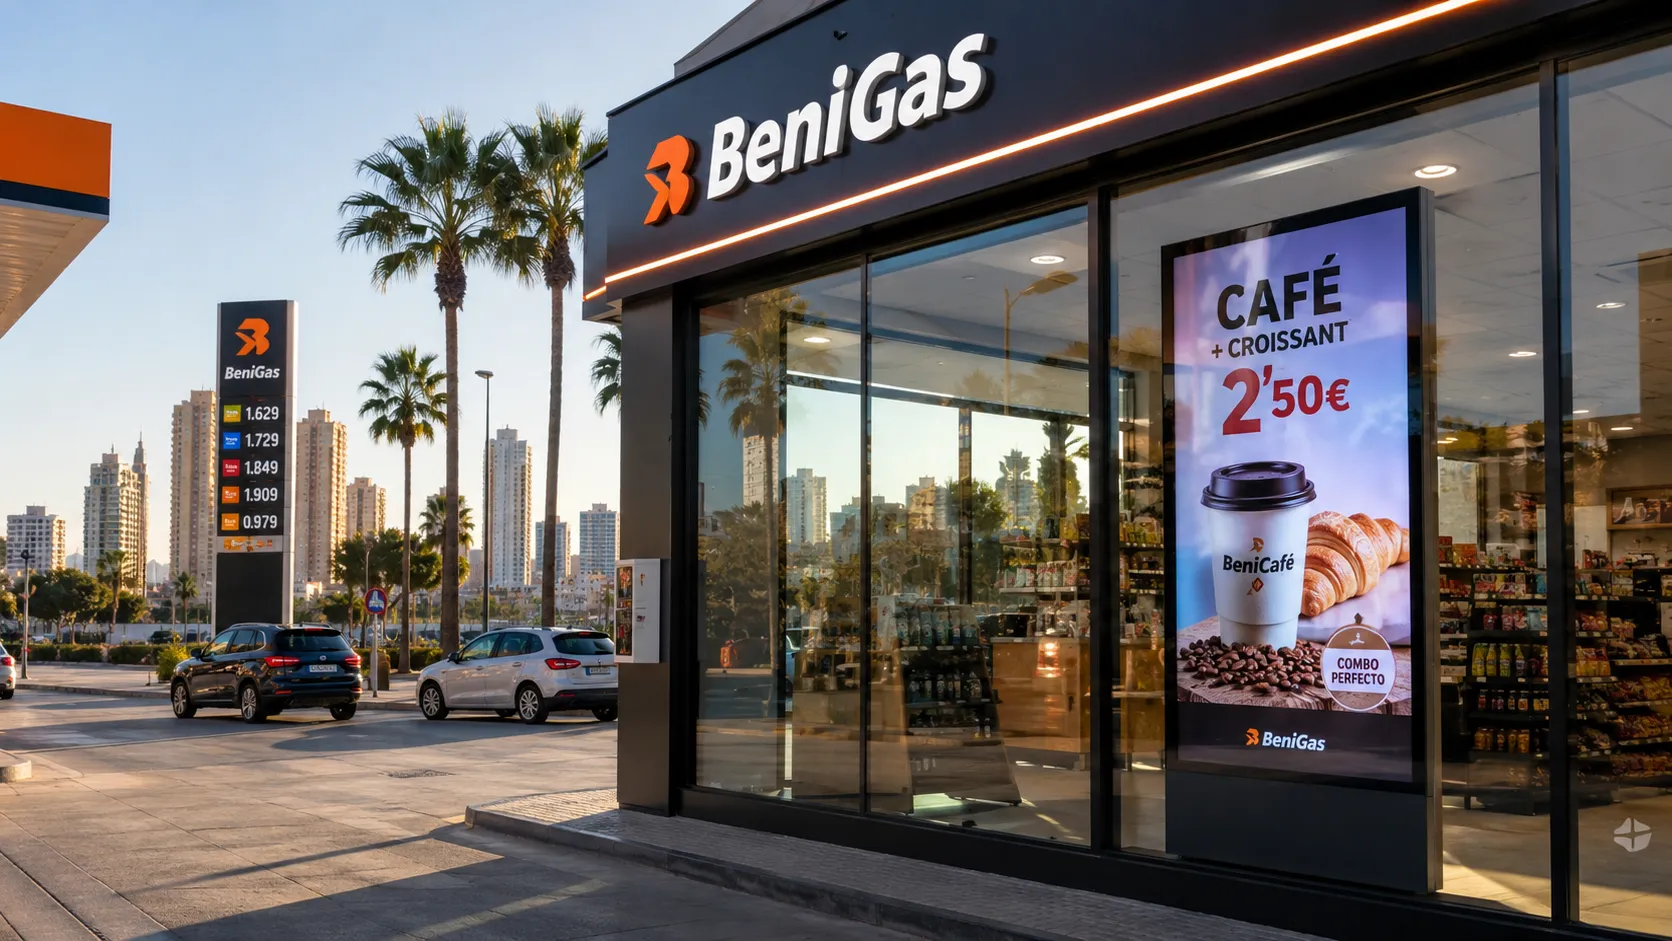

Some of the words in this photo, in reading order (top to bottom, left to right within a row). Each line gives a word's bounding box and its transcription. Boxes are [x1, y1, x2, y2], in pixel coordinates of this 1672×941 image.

[707, 33, 989, 200] BeniGas
[1217, 253, 1342, 330] CAFÉ
[1211, 344, 1223, 359] +
[1228, 321, 1348, 358] CROISSANT
[224, 365, 280, 381] BeniGas
[246, 405, 279, 421] 1.629
[245, 432, 279, 448] 1.729
[244, 460, 278, 475] 1.849
[244, 487, 278, 502] 1.909
[243, 514, 278, 530] 0.979
[1223, 553, 1294, 574] BeniCafé
[1337, 656, 1379, 670] COMBO
[1331, 671, 1385, 685] PERFECTO
[1262, 731, 1326, 752] BeniGas
